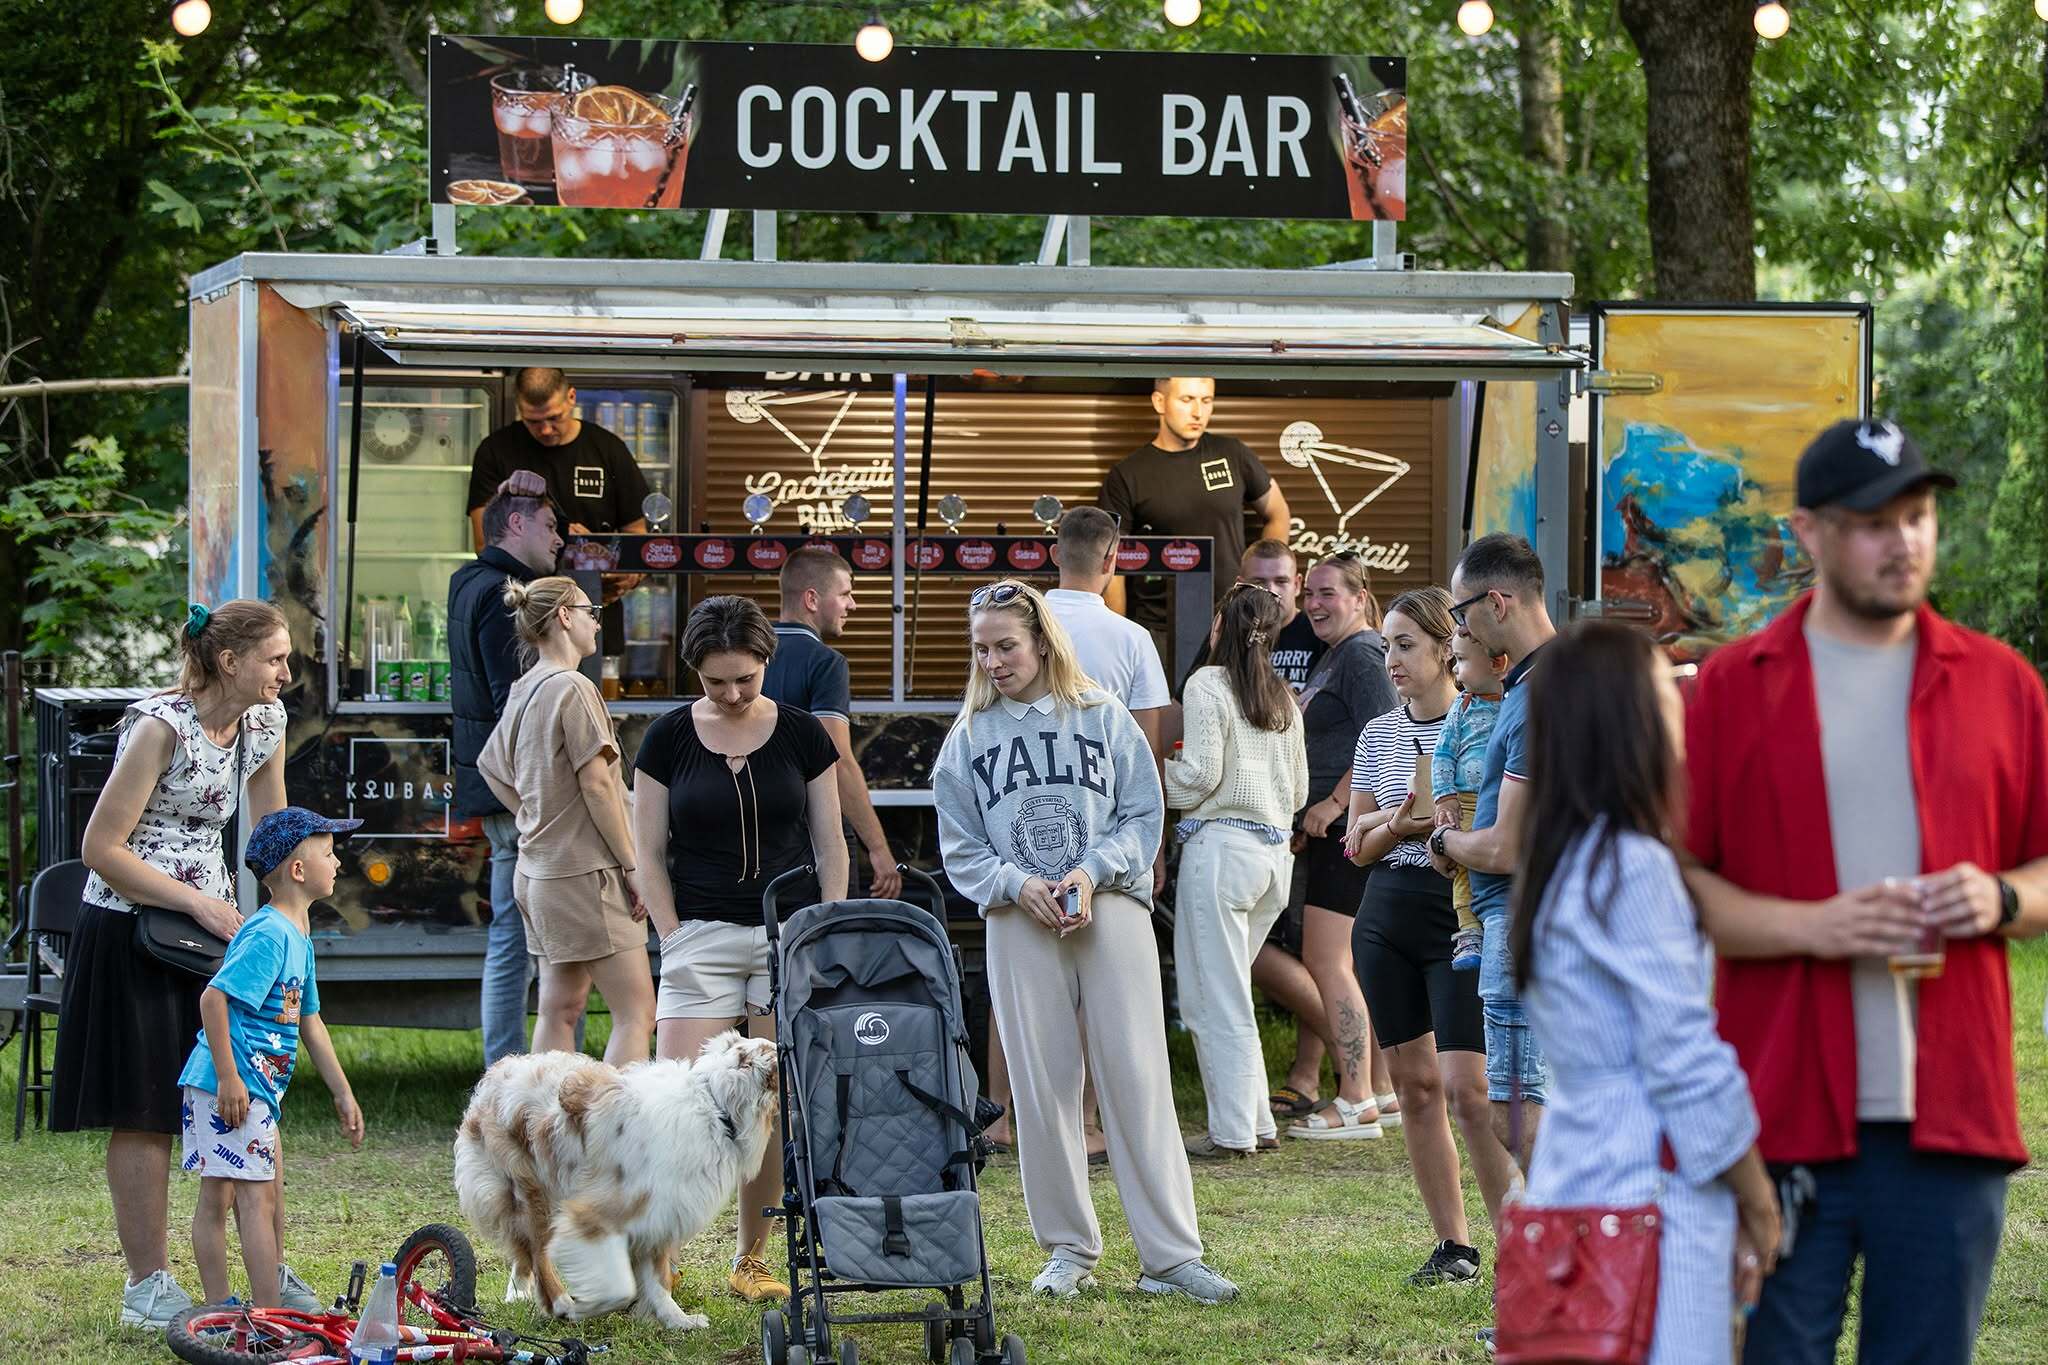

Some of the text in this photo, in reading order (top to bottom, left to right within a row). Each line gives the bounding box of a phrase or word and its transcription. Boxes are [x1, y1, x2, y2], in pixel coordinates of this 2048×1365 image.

[737, 84, 1312, 178] COCKTAIL BAR
[754, 550, 780, 559] Sidras
[864, 545, 877, 553] Gin
[1015, 550, 1040, 560] Sidras
[1117, 551, 1147, 560] rosecco
[703, 554, 725, 563] Blanc
[862, 554, 881, 563] Tonic
[1271, 650, 1312, 666] ORRY
[1289, 668, 1308, 681] MY
[972, 732, 1107, 811] YALE
[346, 780, 453, 799] KOUBAS
[183, 1149, 200, 1170] ONIC
[212, 1143, 245, 1169] SONIC
